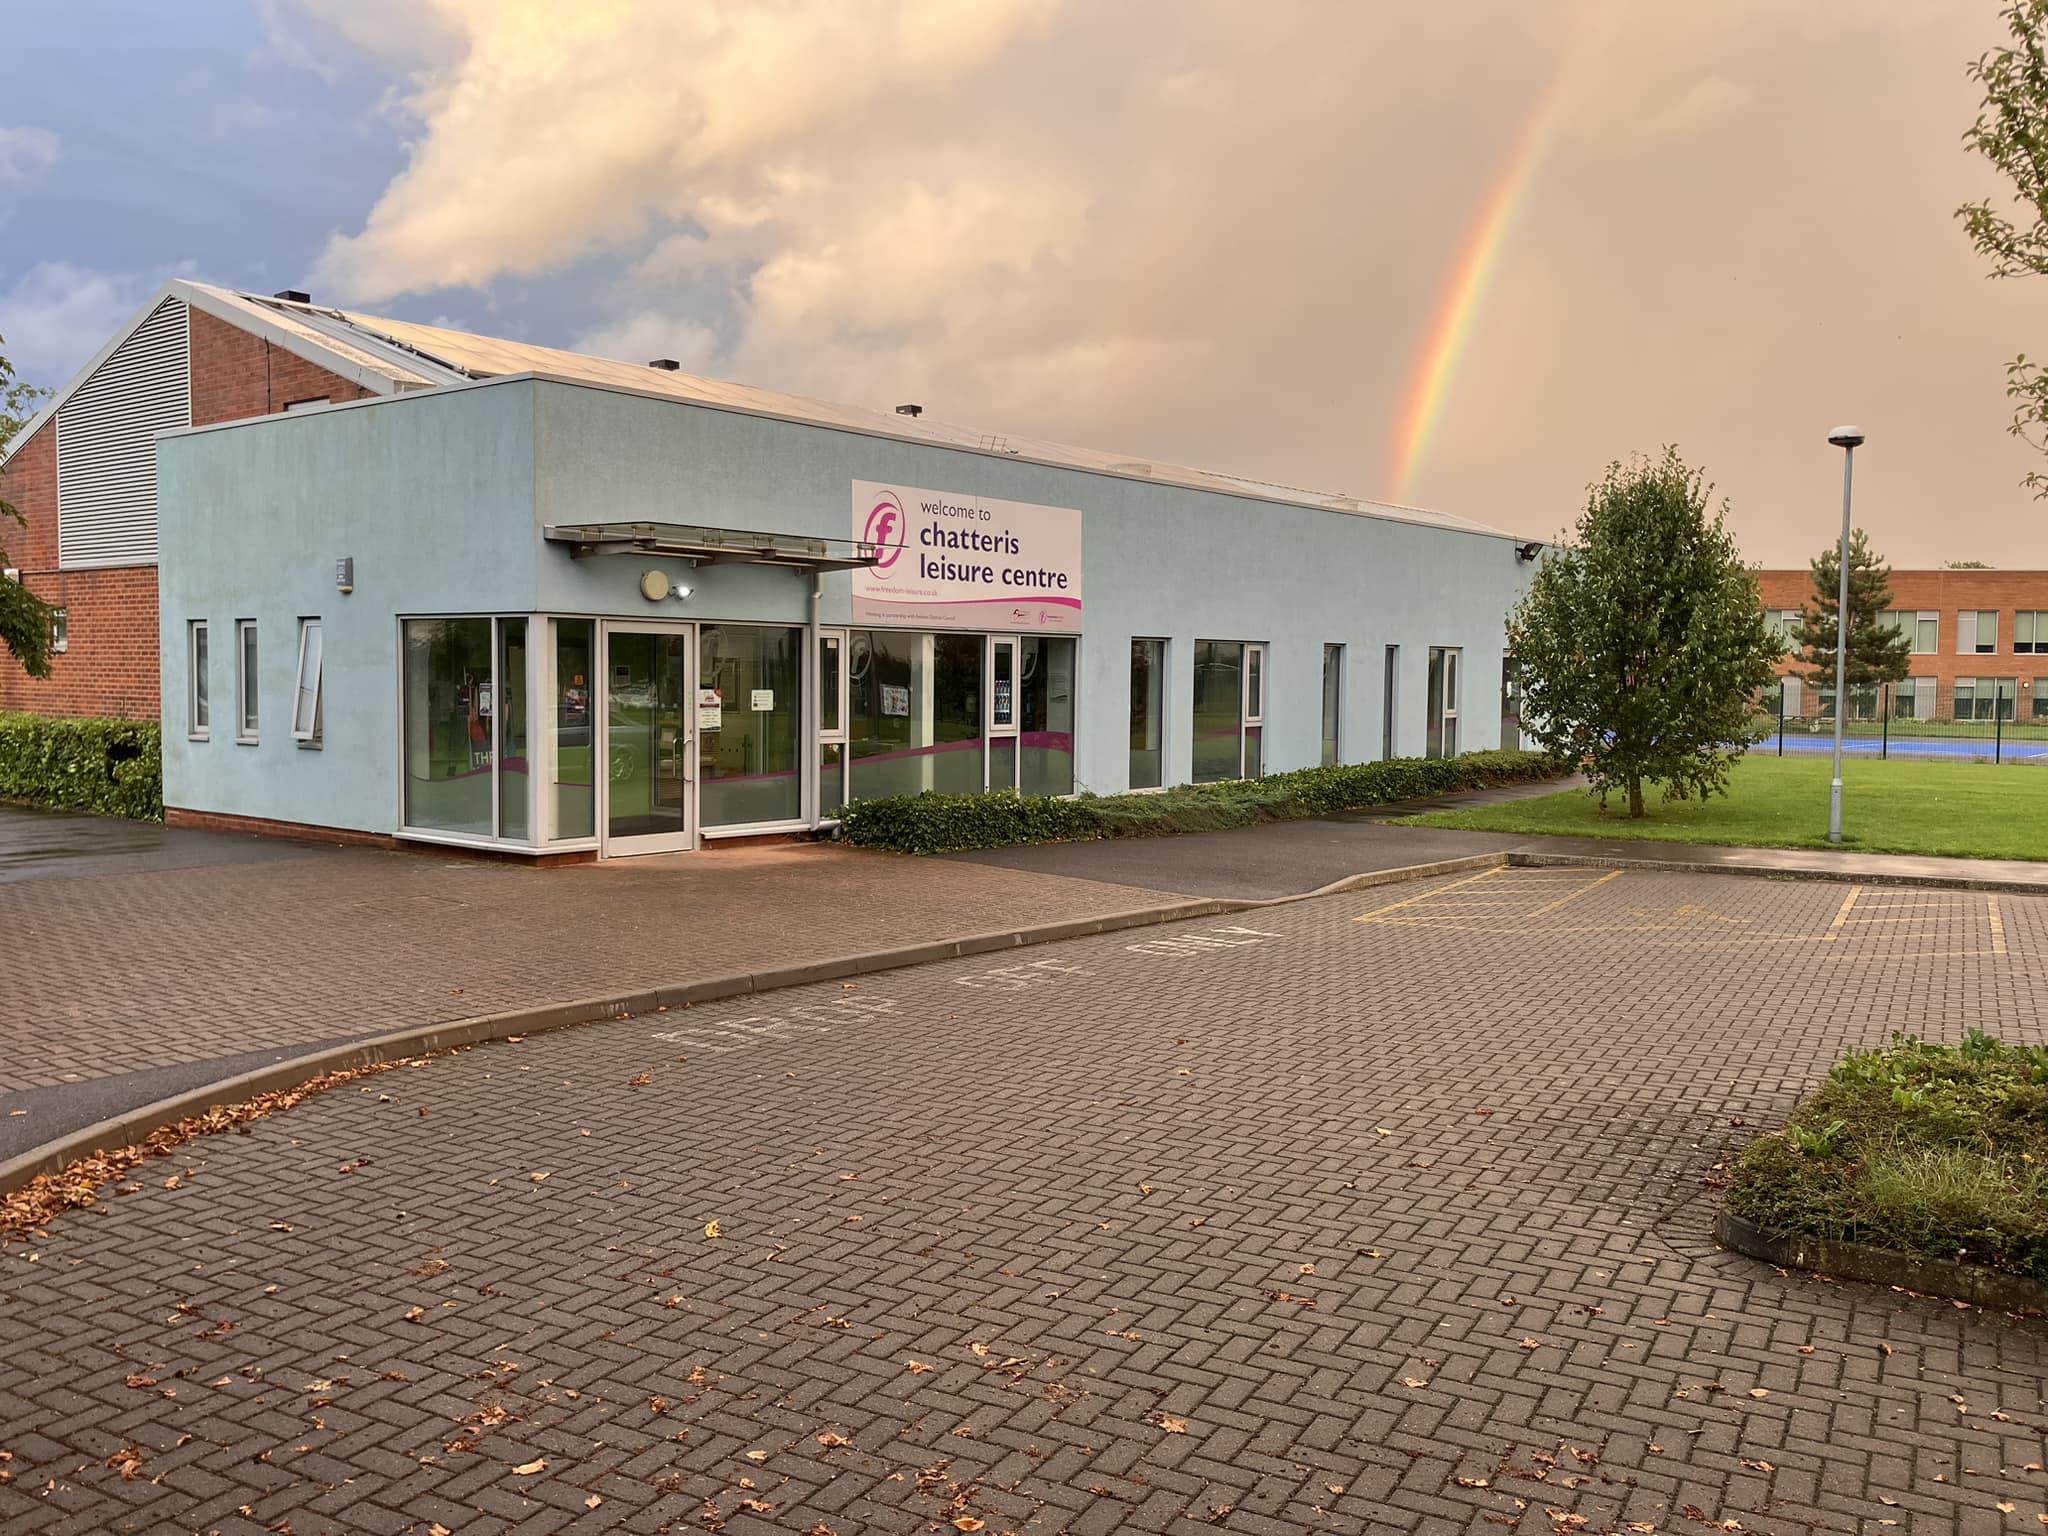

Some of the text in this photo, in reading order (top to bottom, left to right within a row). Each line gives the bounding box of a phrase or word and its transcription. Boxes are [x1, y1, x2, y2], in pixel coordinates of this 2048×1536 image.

[921, 500, 991, 521] welcome to
[920, 521, 1020, 555] chatteris
[920, 553, 1068, 589] leisure centre
